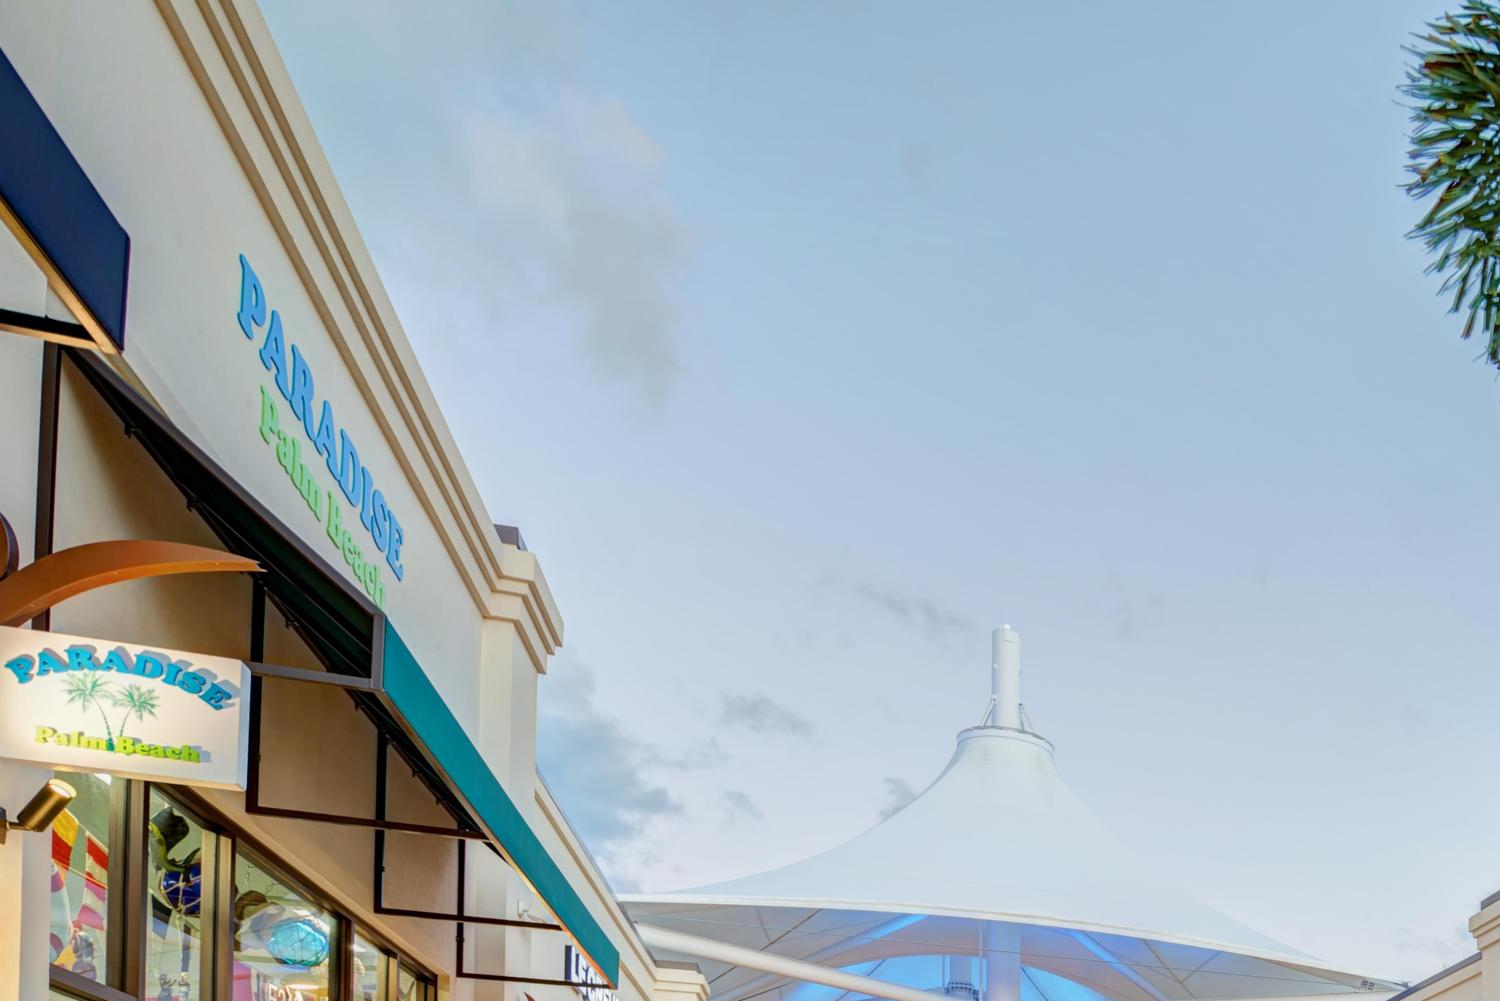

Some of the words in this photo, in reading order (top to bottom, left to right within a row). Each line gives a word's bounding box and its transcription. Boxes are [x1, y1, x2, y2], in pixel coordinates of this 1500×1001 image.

[237, 253, 404, 582] PARADISE
[260, 384, 322, 522] Palm
[326, 490, 387, 607] Beach
[4, 646, 233, 711] PARADISE
[34, 725, 107, 751] Palm
[116, 735, 201, 763] Beach
